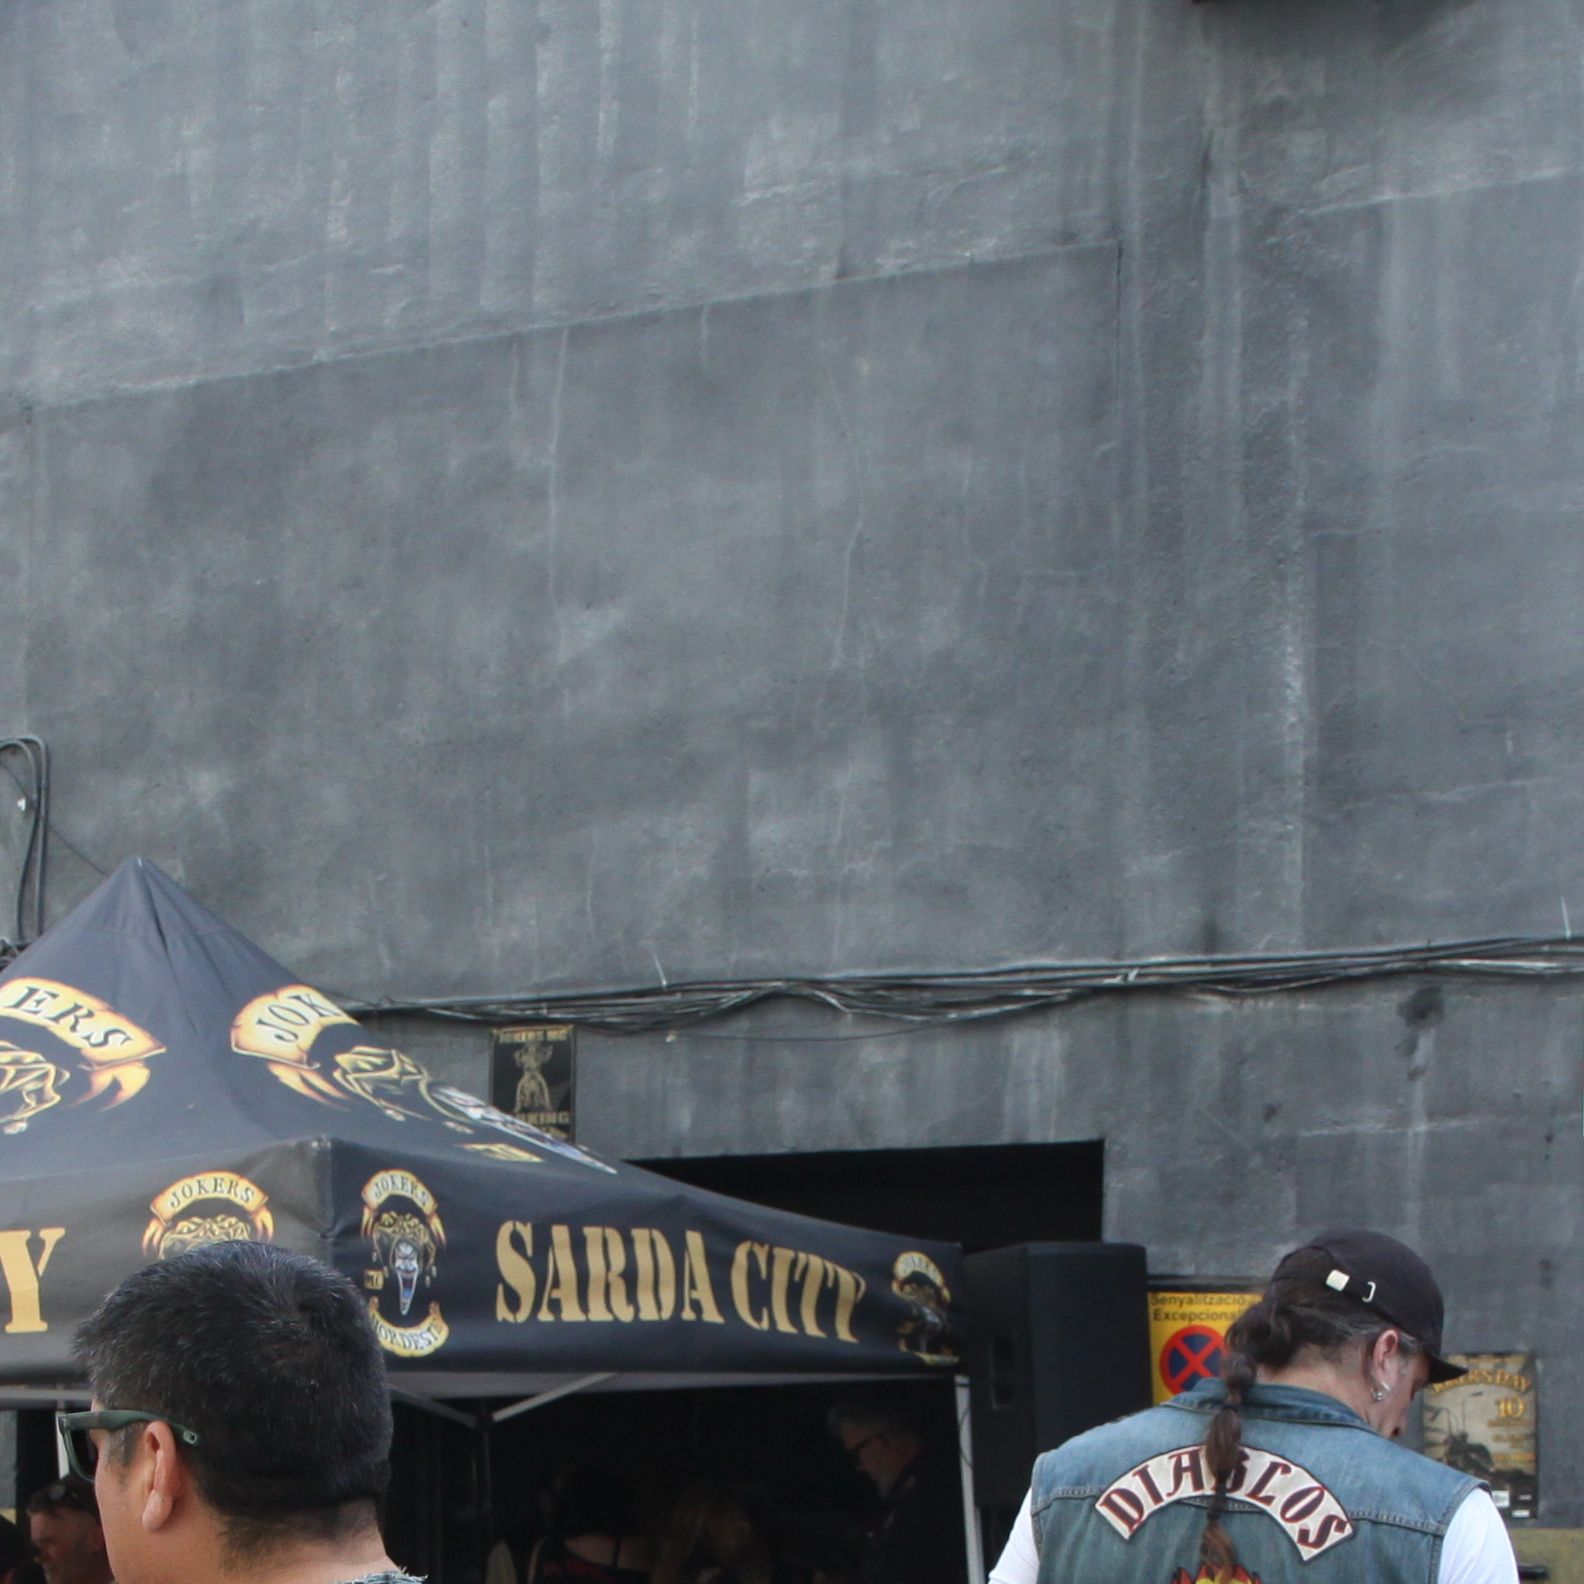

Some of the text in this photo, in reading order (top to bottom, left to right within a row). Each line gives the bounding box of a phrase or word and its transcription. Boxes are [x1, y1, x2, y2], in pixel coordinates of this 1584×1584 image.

[8, 984, 134, 1050] ERS
[254, 992, 342, 1044] JOK
[169, 1176, 256, 1210] JOKERS
[373, 1174, 430, 1207] JOKERS
[495, 1219, 867, 1345] SARDA CITY
